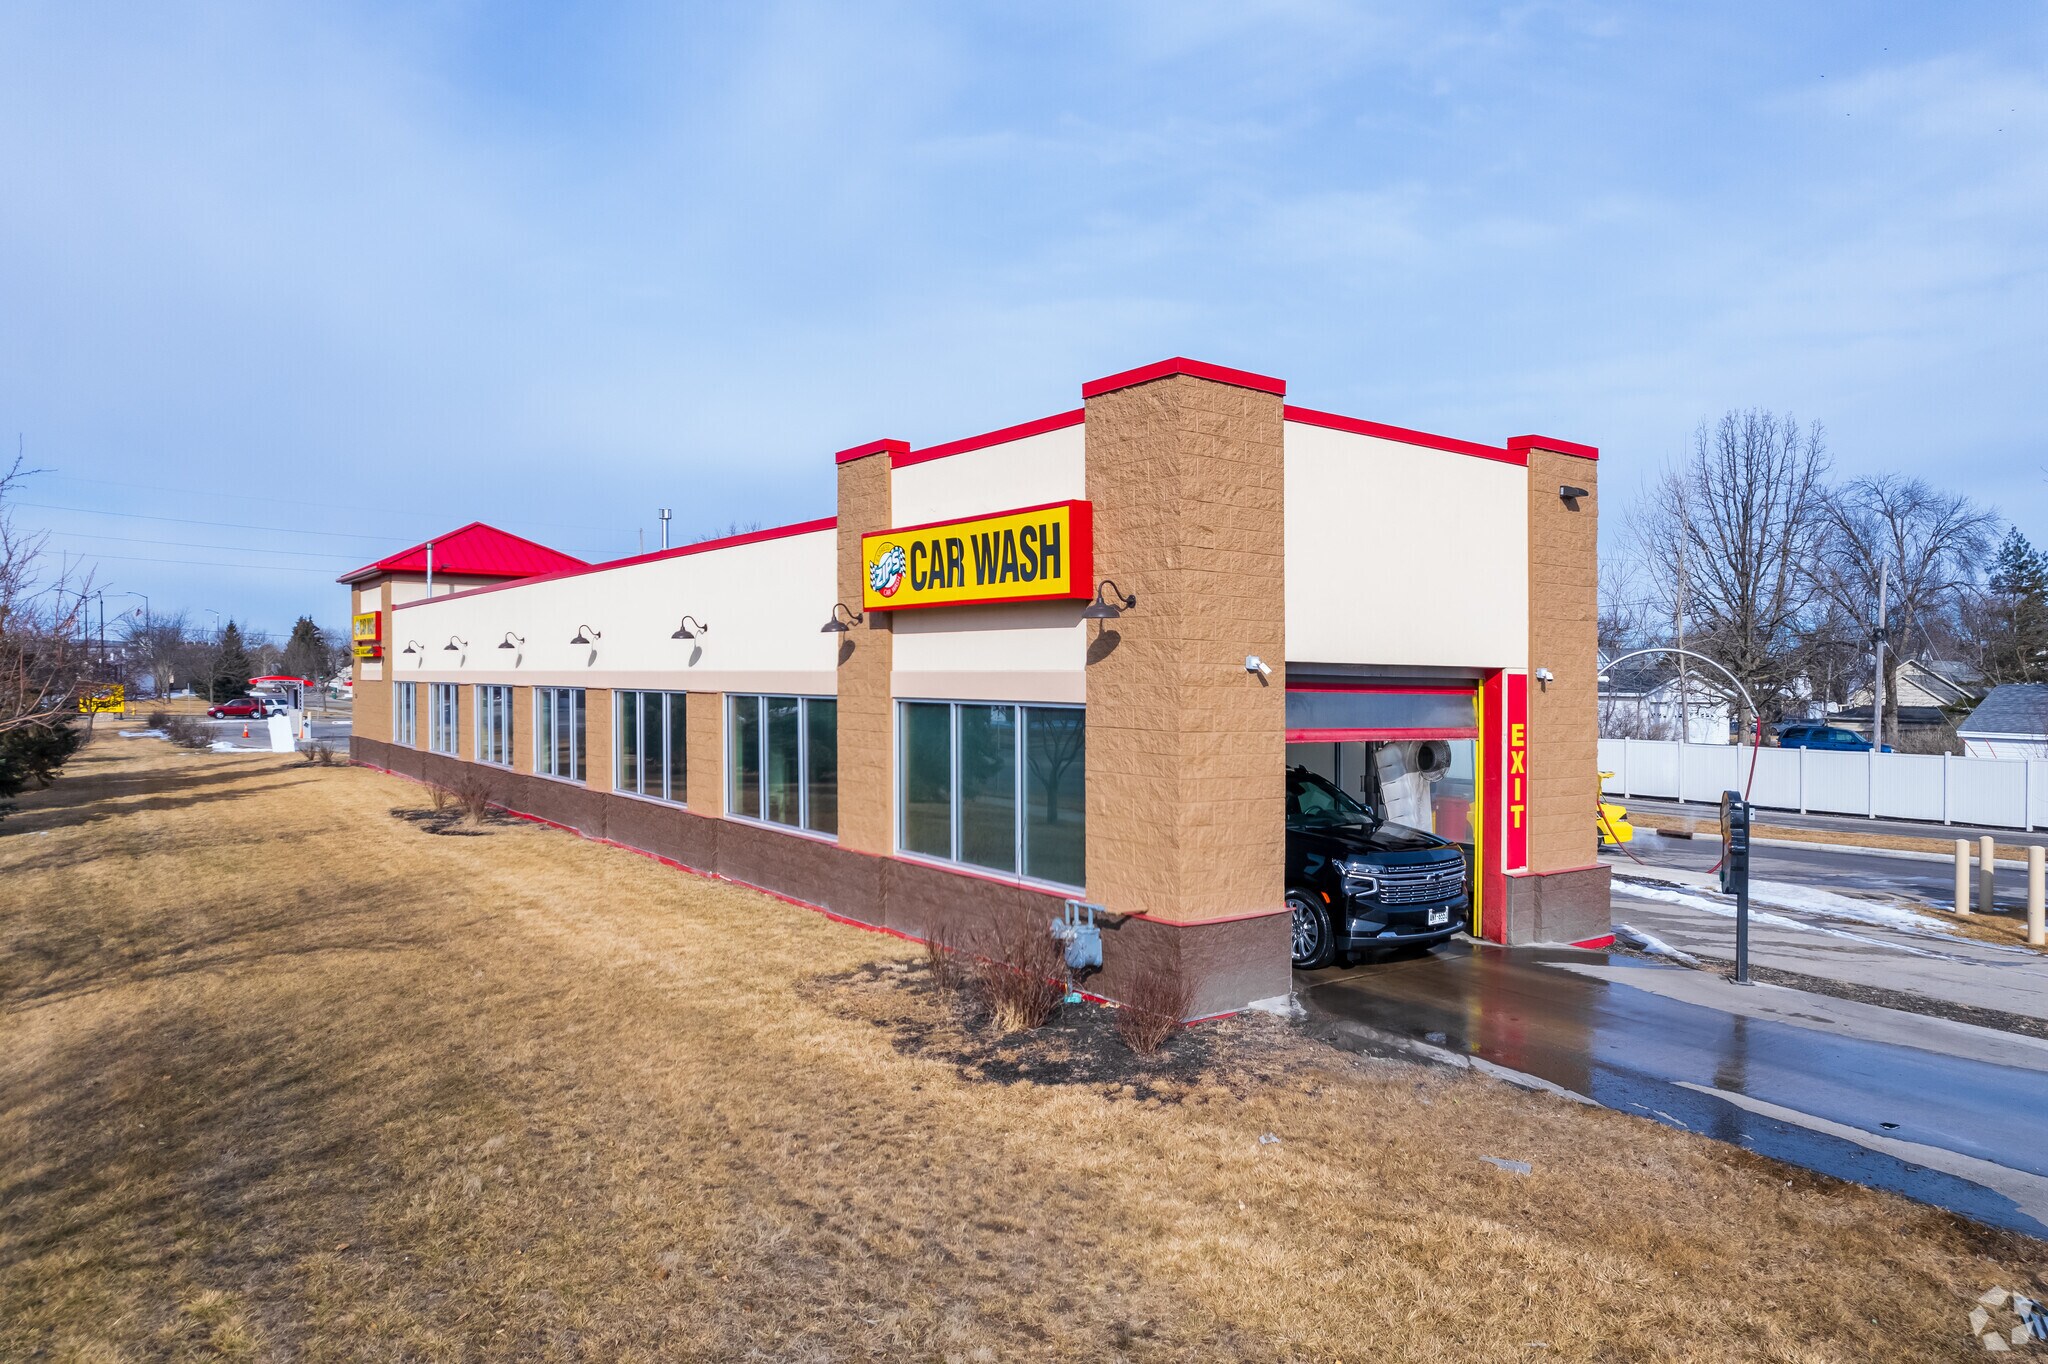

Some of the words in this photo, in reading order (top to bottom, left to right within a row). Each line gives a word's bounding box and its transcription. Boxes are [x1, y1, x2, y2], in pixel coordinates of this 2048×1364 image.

[874, 549, 900, 589] ZIPS
[910, 537, 965, 591] CAR
[970, 522, 1061, 586] WASH
[1510, 723, 1525, 829] EXIT
